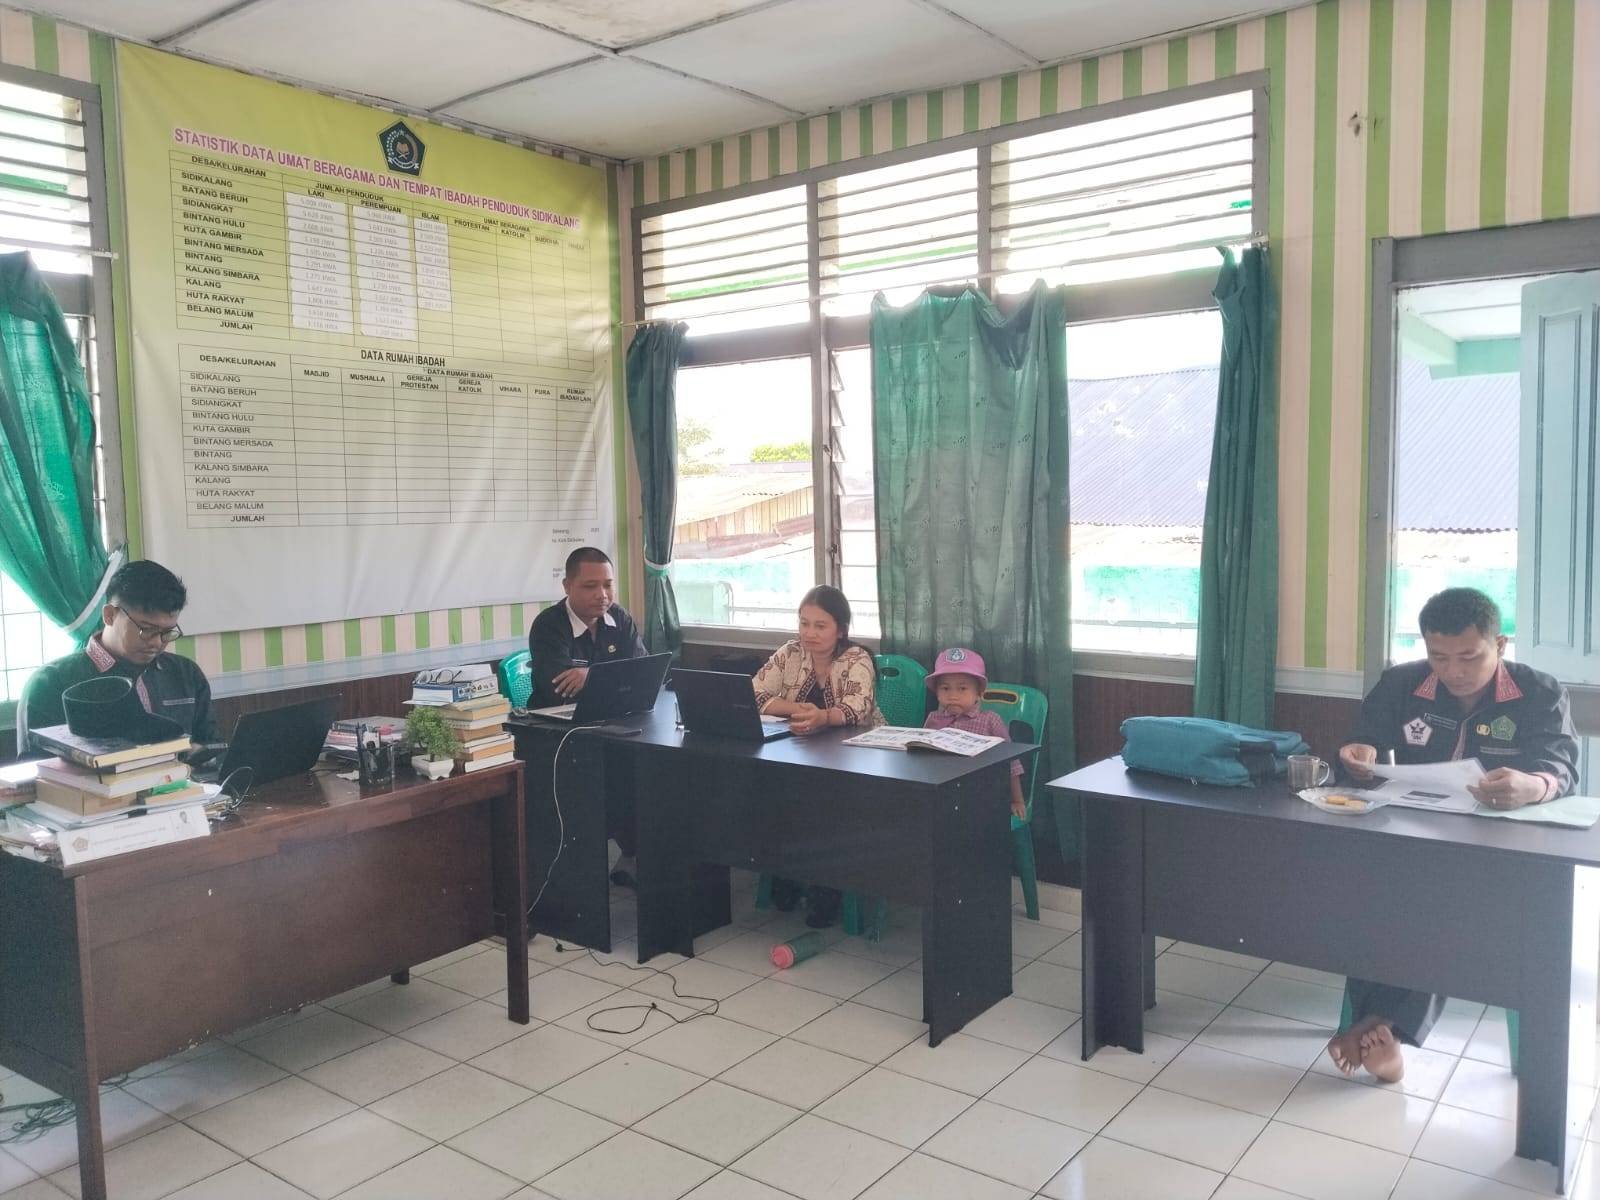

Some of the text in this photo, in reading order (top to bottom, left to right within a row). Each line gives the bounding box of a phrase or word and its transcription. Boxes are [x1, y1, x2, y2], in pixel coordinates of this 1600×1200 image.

[174, 128, 239, 155] STATISTIK
[242, 143, 275, 163] DATA
[278, 153, 311, 171] UMAT
[313, 160, 376, 186] BERAGAMA
[378, 174, 400, 190] DAN
[402, 179, 442, 200] TEMPAT
[444, 189, 480, 208] IBADAH
[482, 198, 530, 219] PENDUDUK
[181, 171, 233, 188] SIDIKALANG
[182, 184, 248, 204] BATANG BERUH
[308, 189, 325, 198] LAKI
[315, 183, 345, 195] JUMLAH
[182, 198, 234, 213] SIDIANGKAT
[360, 200, 401, 213] PEREMPUAN
[183, 211, 245, 229] BINTANG HULU
[421, 212, 439, 221] ISLAM
[454, 219, 490, 232] PROTESTAN
[183, 225, 242, 240] KUTA GAMBIR
[501, 229, 525, 239] KATOLIK
[184, 238, 264, 257] BINTANG MERSADA
[184, 251, 223, 263] BINTANG
[185, 264, 260, 281] KALANG SIMBARA
[186, 278, 222, 289] KALANG
[186, 291, 245, 305] HUTA RAKYAT
[187, 304, 254, 318] BELANG MALUM
[219, 320, 253, 330] JUMLAH
[199, 354, 276, 368] DESA/KELURAHAN
[360, 349, 445, 367] DATA RUMAH IBADAH
[190, 372, 241, 383] SIDIKALANG
[427, 368, 445, 376] DATA
[350, 373, 385, 383] MUSHALLA
[406, 374, 432, 382] GEREJA
[190, 385, 257, 396] BATANG BERUH
[401, 381, 439, 390] PROTESTAN
[191, 399, 242, 408] SIDIANGKAT
[192, 411, 254, 422] BINTANG HULU
[193, 425, 250, 434] KUTA GAMBIR
[193, 437, 273, 447] BINTANG MERSADA
[194, 464, 229, 472] KALANG
[195, 476, 231, 484] KALANG
[196, 502, 264, 510] BELANG MALUM
[230, 515, 265, 523] JUMLAH
